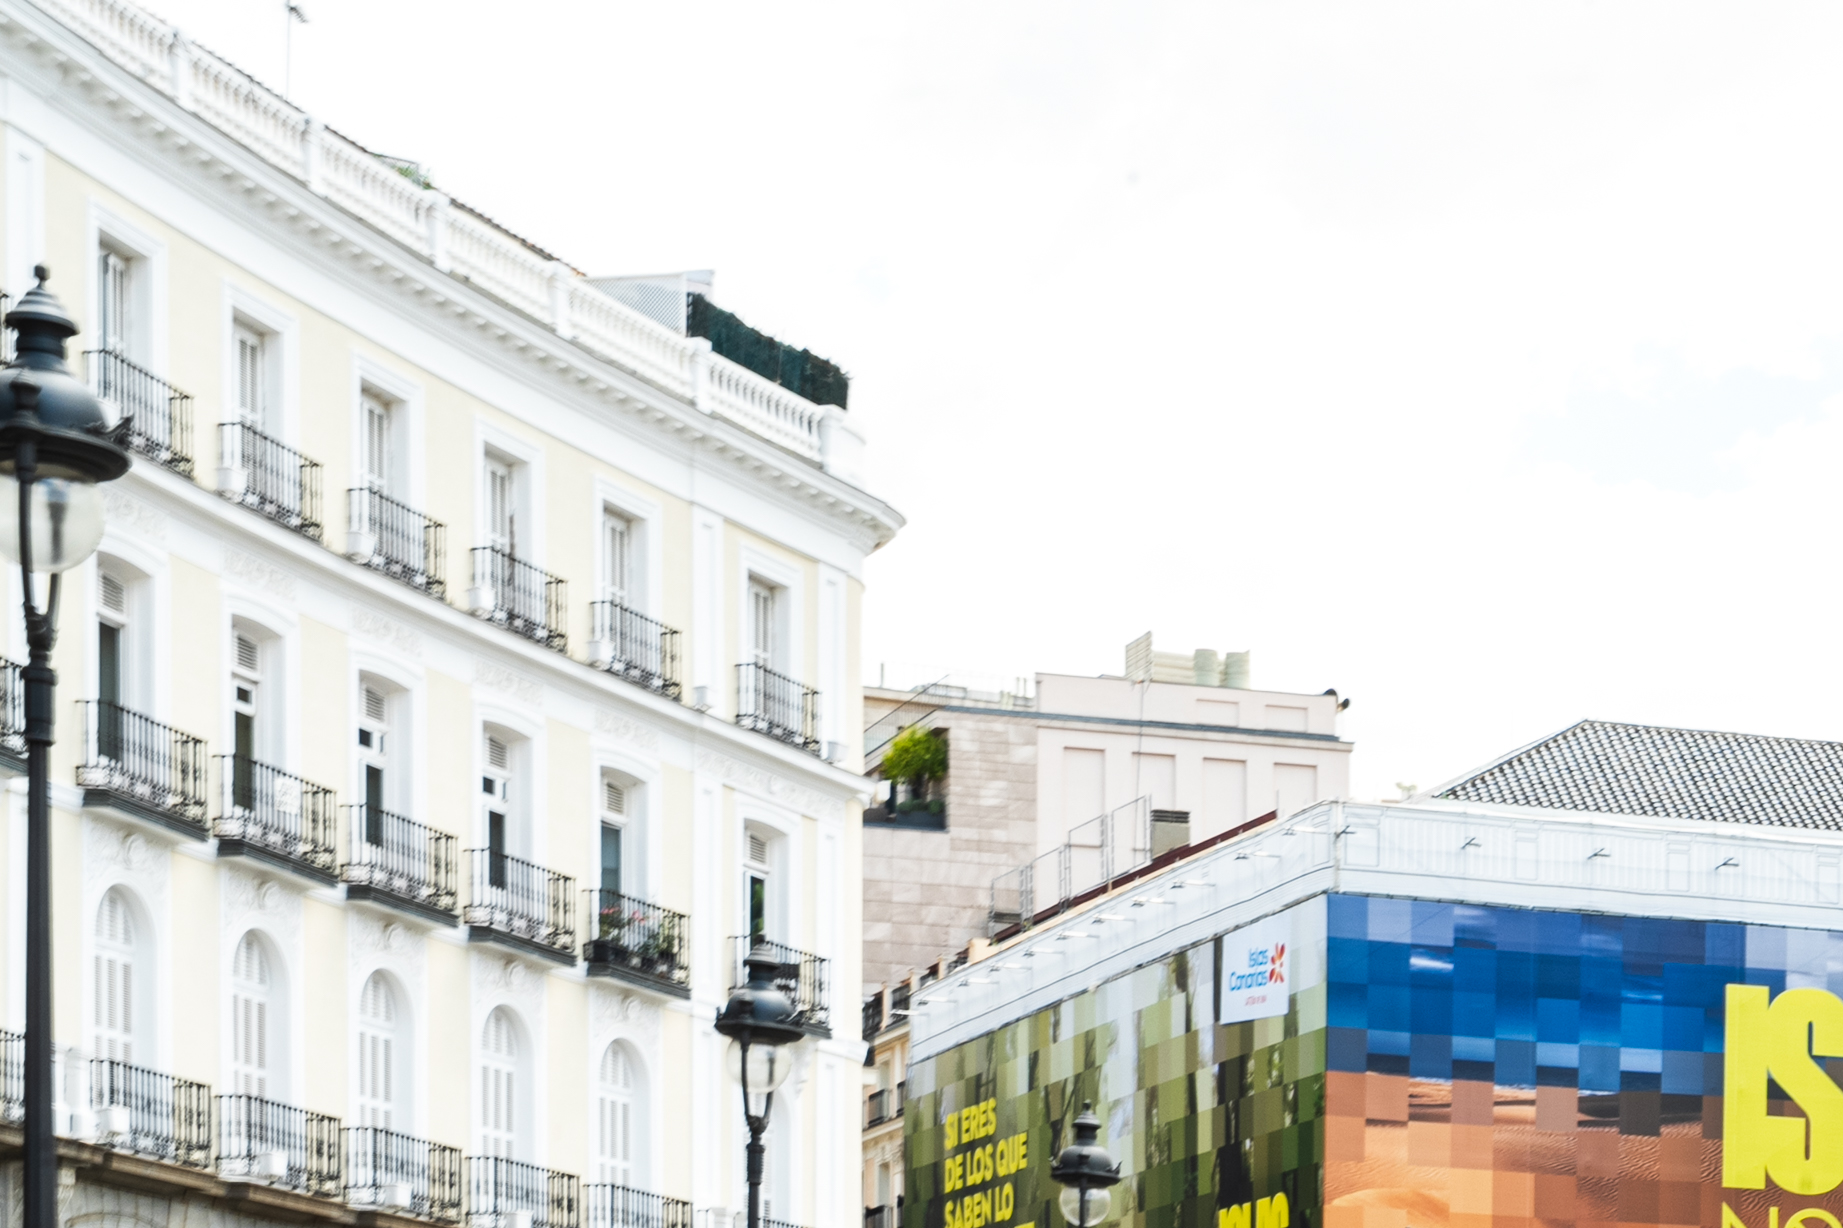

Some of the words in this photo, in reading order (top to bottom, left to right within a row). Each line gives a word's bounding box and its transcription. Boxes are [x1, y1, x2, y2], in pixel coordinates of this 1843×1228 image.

[1248, 947, 1269, 968] Islas
[1229, 970, 1268, 992] Canarias
[944, 1111, 958, 1150] SI
[961, 1097, 997, 1143] ERES
[944, 1152, 964, 1194] DE
[966, 1142, 994, 1185] LOS
[996, 1131, 1028, 1177] QUE
[994, 1181, 1014, 1223] LO
